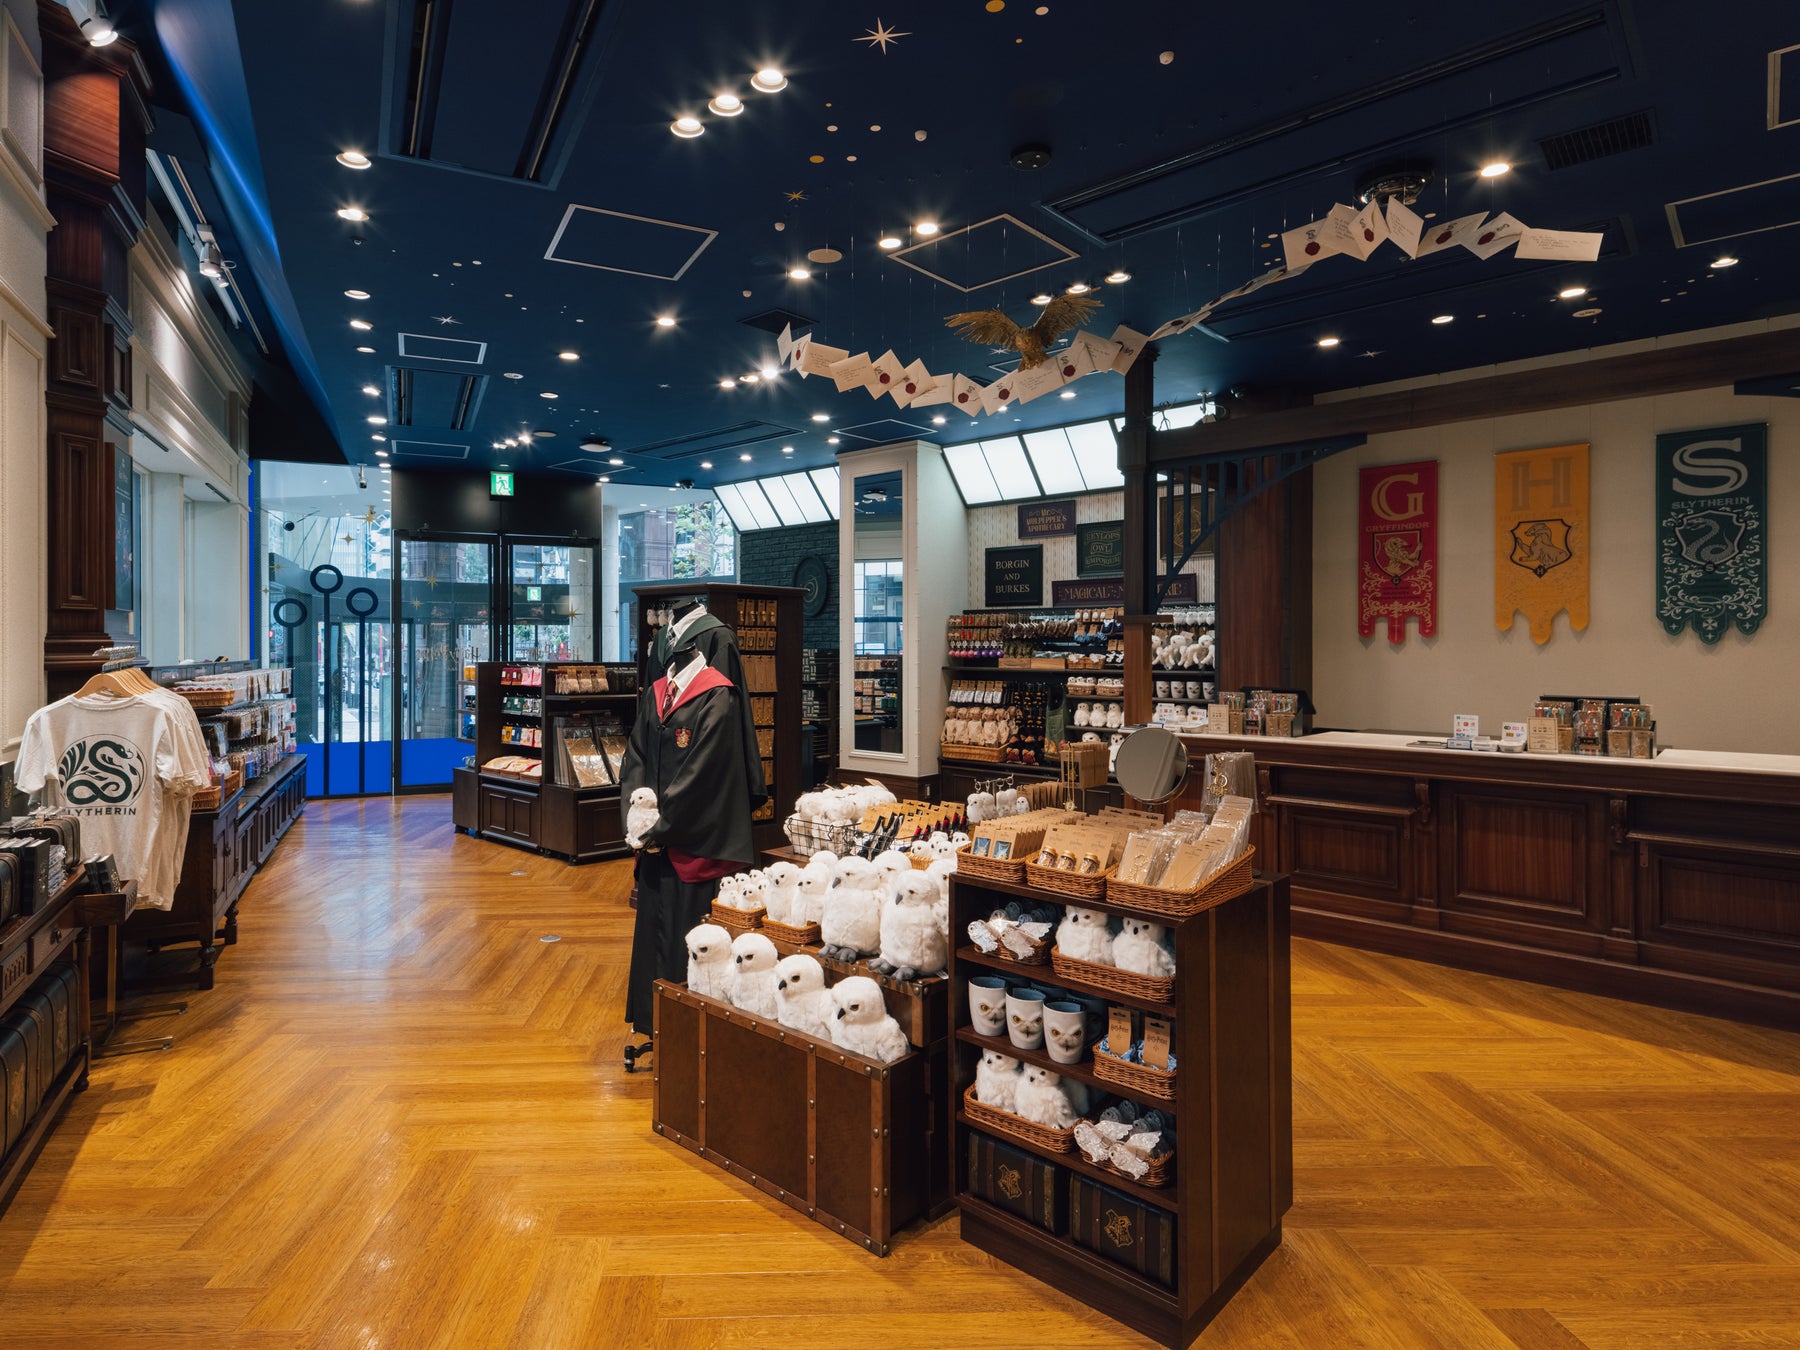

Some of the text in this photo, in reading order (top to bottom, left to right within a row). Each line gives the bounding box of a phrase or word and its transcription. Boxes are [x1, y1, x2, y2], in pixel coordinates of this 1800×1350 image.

[1672, 437, 1749, 497] S
[1511, 456, 1572, 512] H
[1371, 472, 1425, 522] G
[1671, 496, 1750, 510] SLYTHERIN
[1365, 521, 1430, 533] GRYFFINDOR
[1092, 543, 1111, 553] OWL
[995, 559, 1031, 570] BORGIN
[1003, 572, 1021, 581] AND
[995, 583, 1031, 594] BURKES
[1064, 585, 1109, 599] MAGICAL
[64, 807, 136, 816] LYTHERIN
